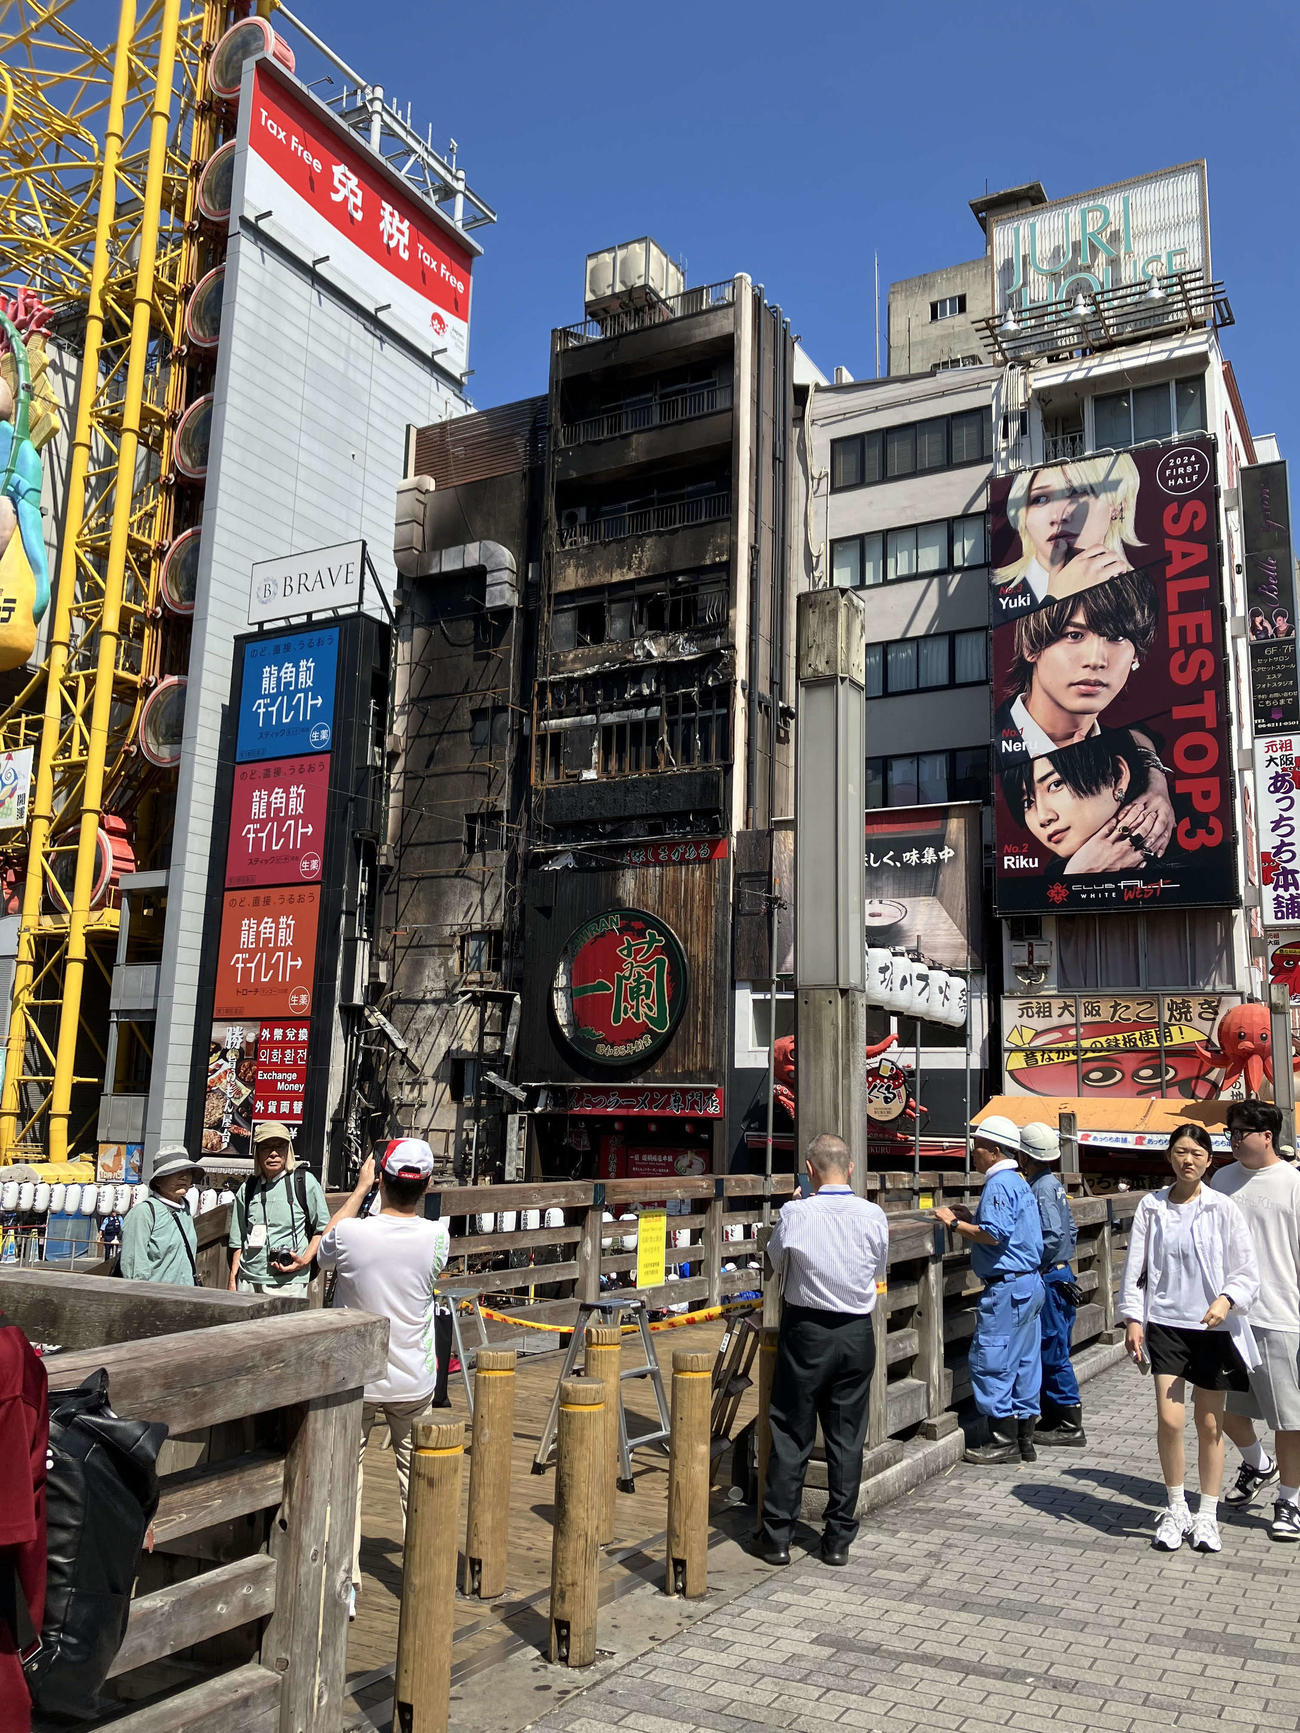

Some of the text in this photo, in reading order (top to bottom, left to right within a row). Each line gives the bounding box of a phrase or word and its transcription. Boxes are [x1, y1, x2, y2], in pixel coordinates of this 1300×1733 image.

[259, 108, 322, 174] Tax Free
[1006, 195, 1134, 295] JURI
[416, 243, 465, 293] Tax Free
[1165, 463, 1201, 477] FIRST
[1169, 455, 1196, 466] 2024
[1168, 474, 1199, 487] HALF
[282, 561, 355, 598] BRAVE
[999, 593, 1031, 610] Yuki
[261, 657, 315, 695] 龍角散
[1162, 499, 1224, 851] SALES TOP3
[252, 691, 323, 728] ダイレクト
[1001, 727, 1024, 737] No.1
[1264, 738, 1294, 754] 元祖
[1265, 753, 1295, 769] 大阪
[251, 783, 306, 820] 龍角散
[241, 819, 314, 853] ダイレクト
[865, 845, 955, 868] しく、味集中
[1003, 843, 1029, 854] No.2
[1003, 855, 1039, 869] Riku
[240, 914, 296, 949] 龍角散
[230, 951, 303, 984] ダイレクト
[572, 929, 670, 1033] 一蘭
[1017, 998, 1220, 1024] 元祖大阪たこ焼き
[258, 1048, 307, 1065] 외화환전
[257, 1071, 298, 1081] Exchange
[276, 1081, 305, 1092] Money
[255, 1100, 304, 1115] 外貨両替
